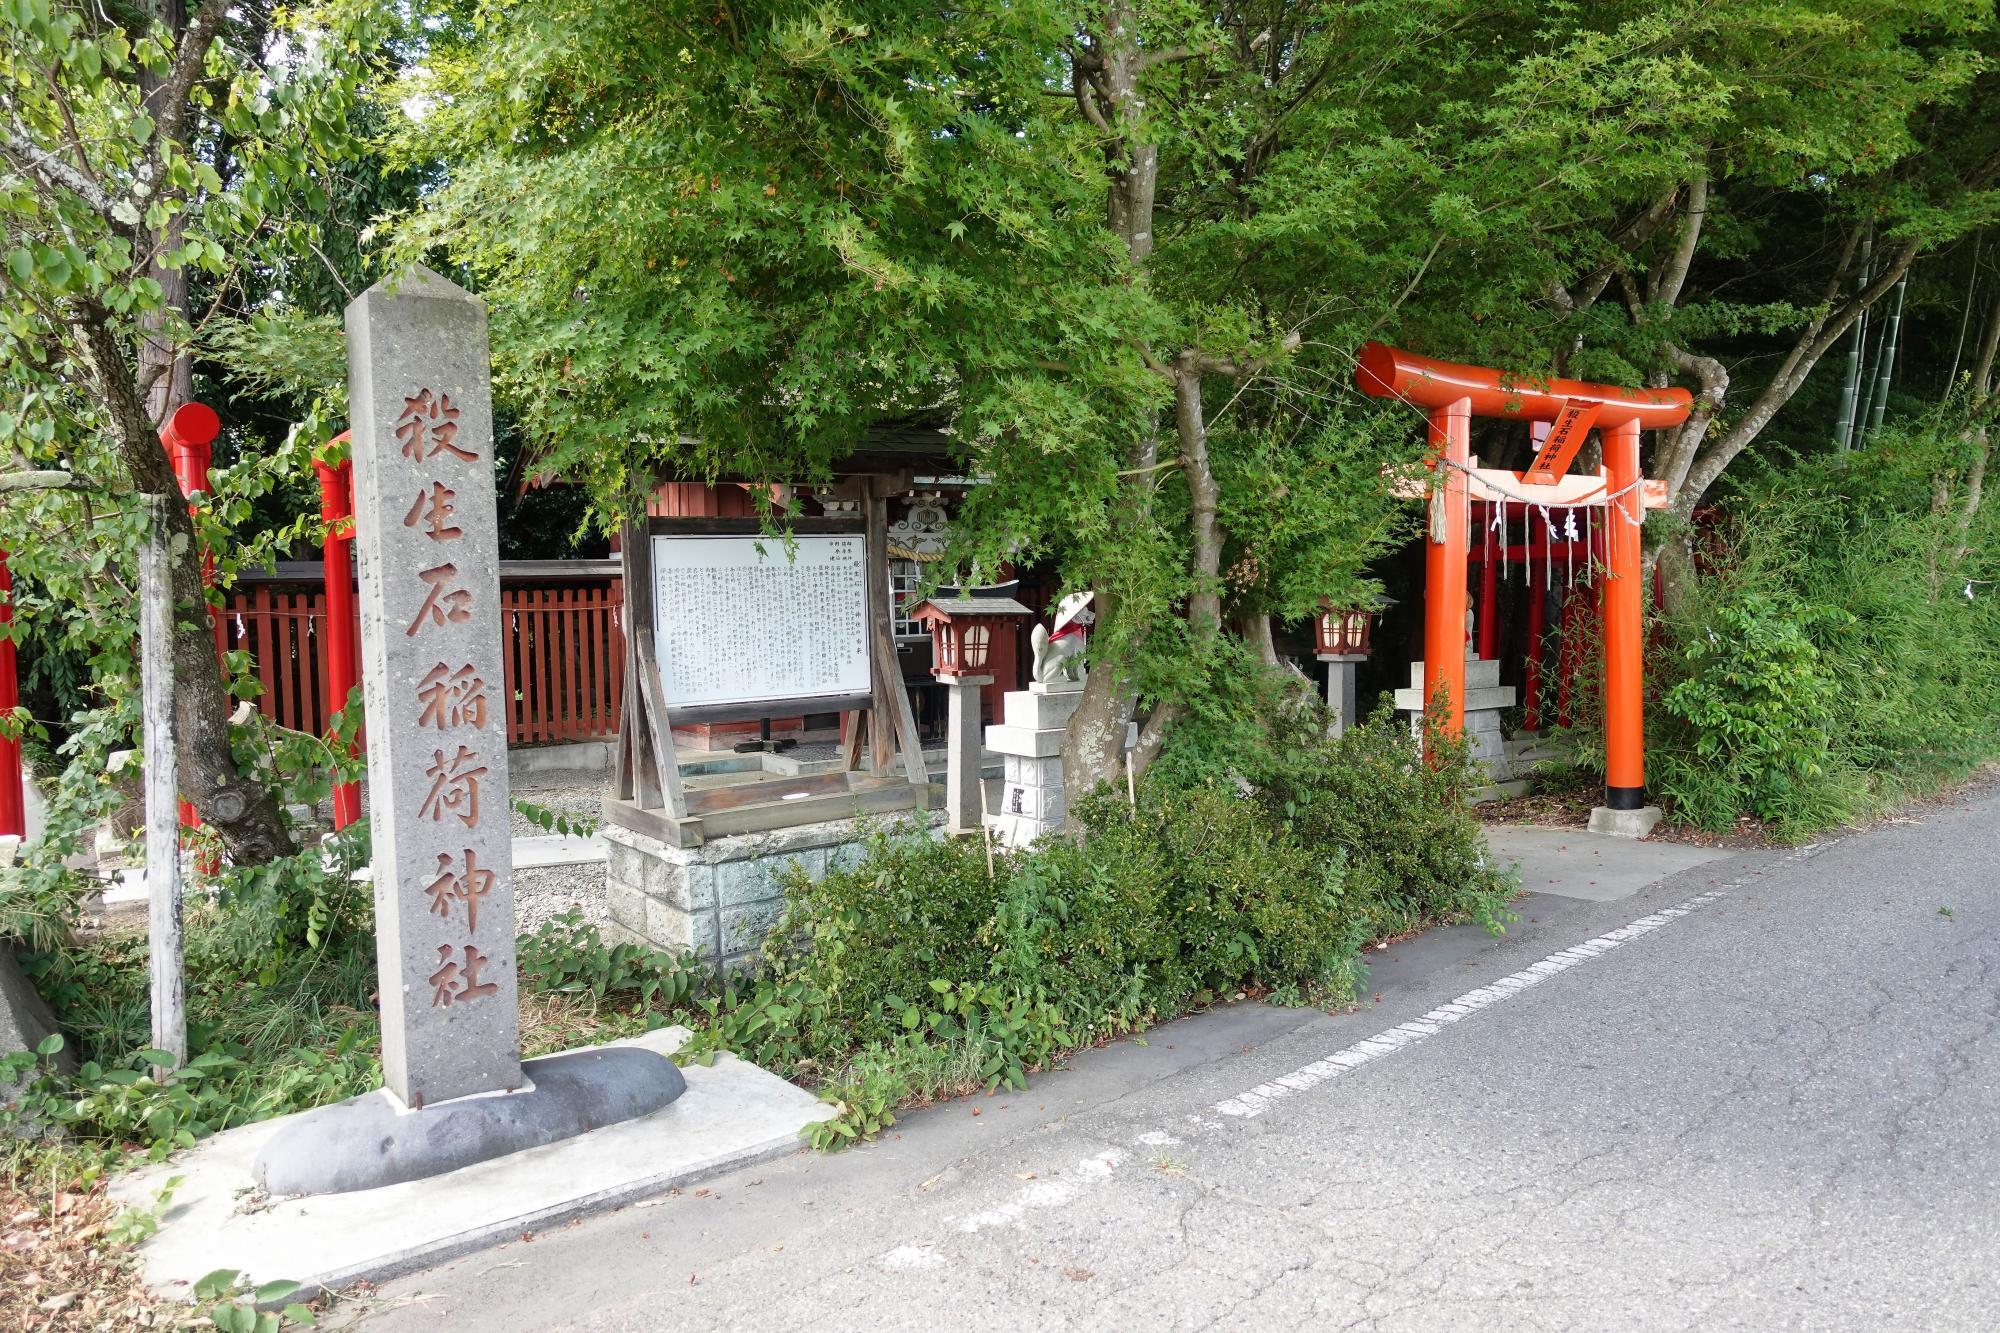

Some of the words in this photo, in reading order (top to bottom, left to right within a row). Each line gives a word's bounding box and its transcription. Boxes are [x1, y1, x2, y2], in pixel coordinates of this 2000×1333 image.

[1539, 409, 1580, 470] 殺生石稲荷神社
[396, 388, 497, 1008] 殺生石稲荷神社
